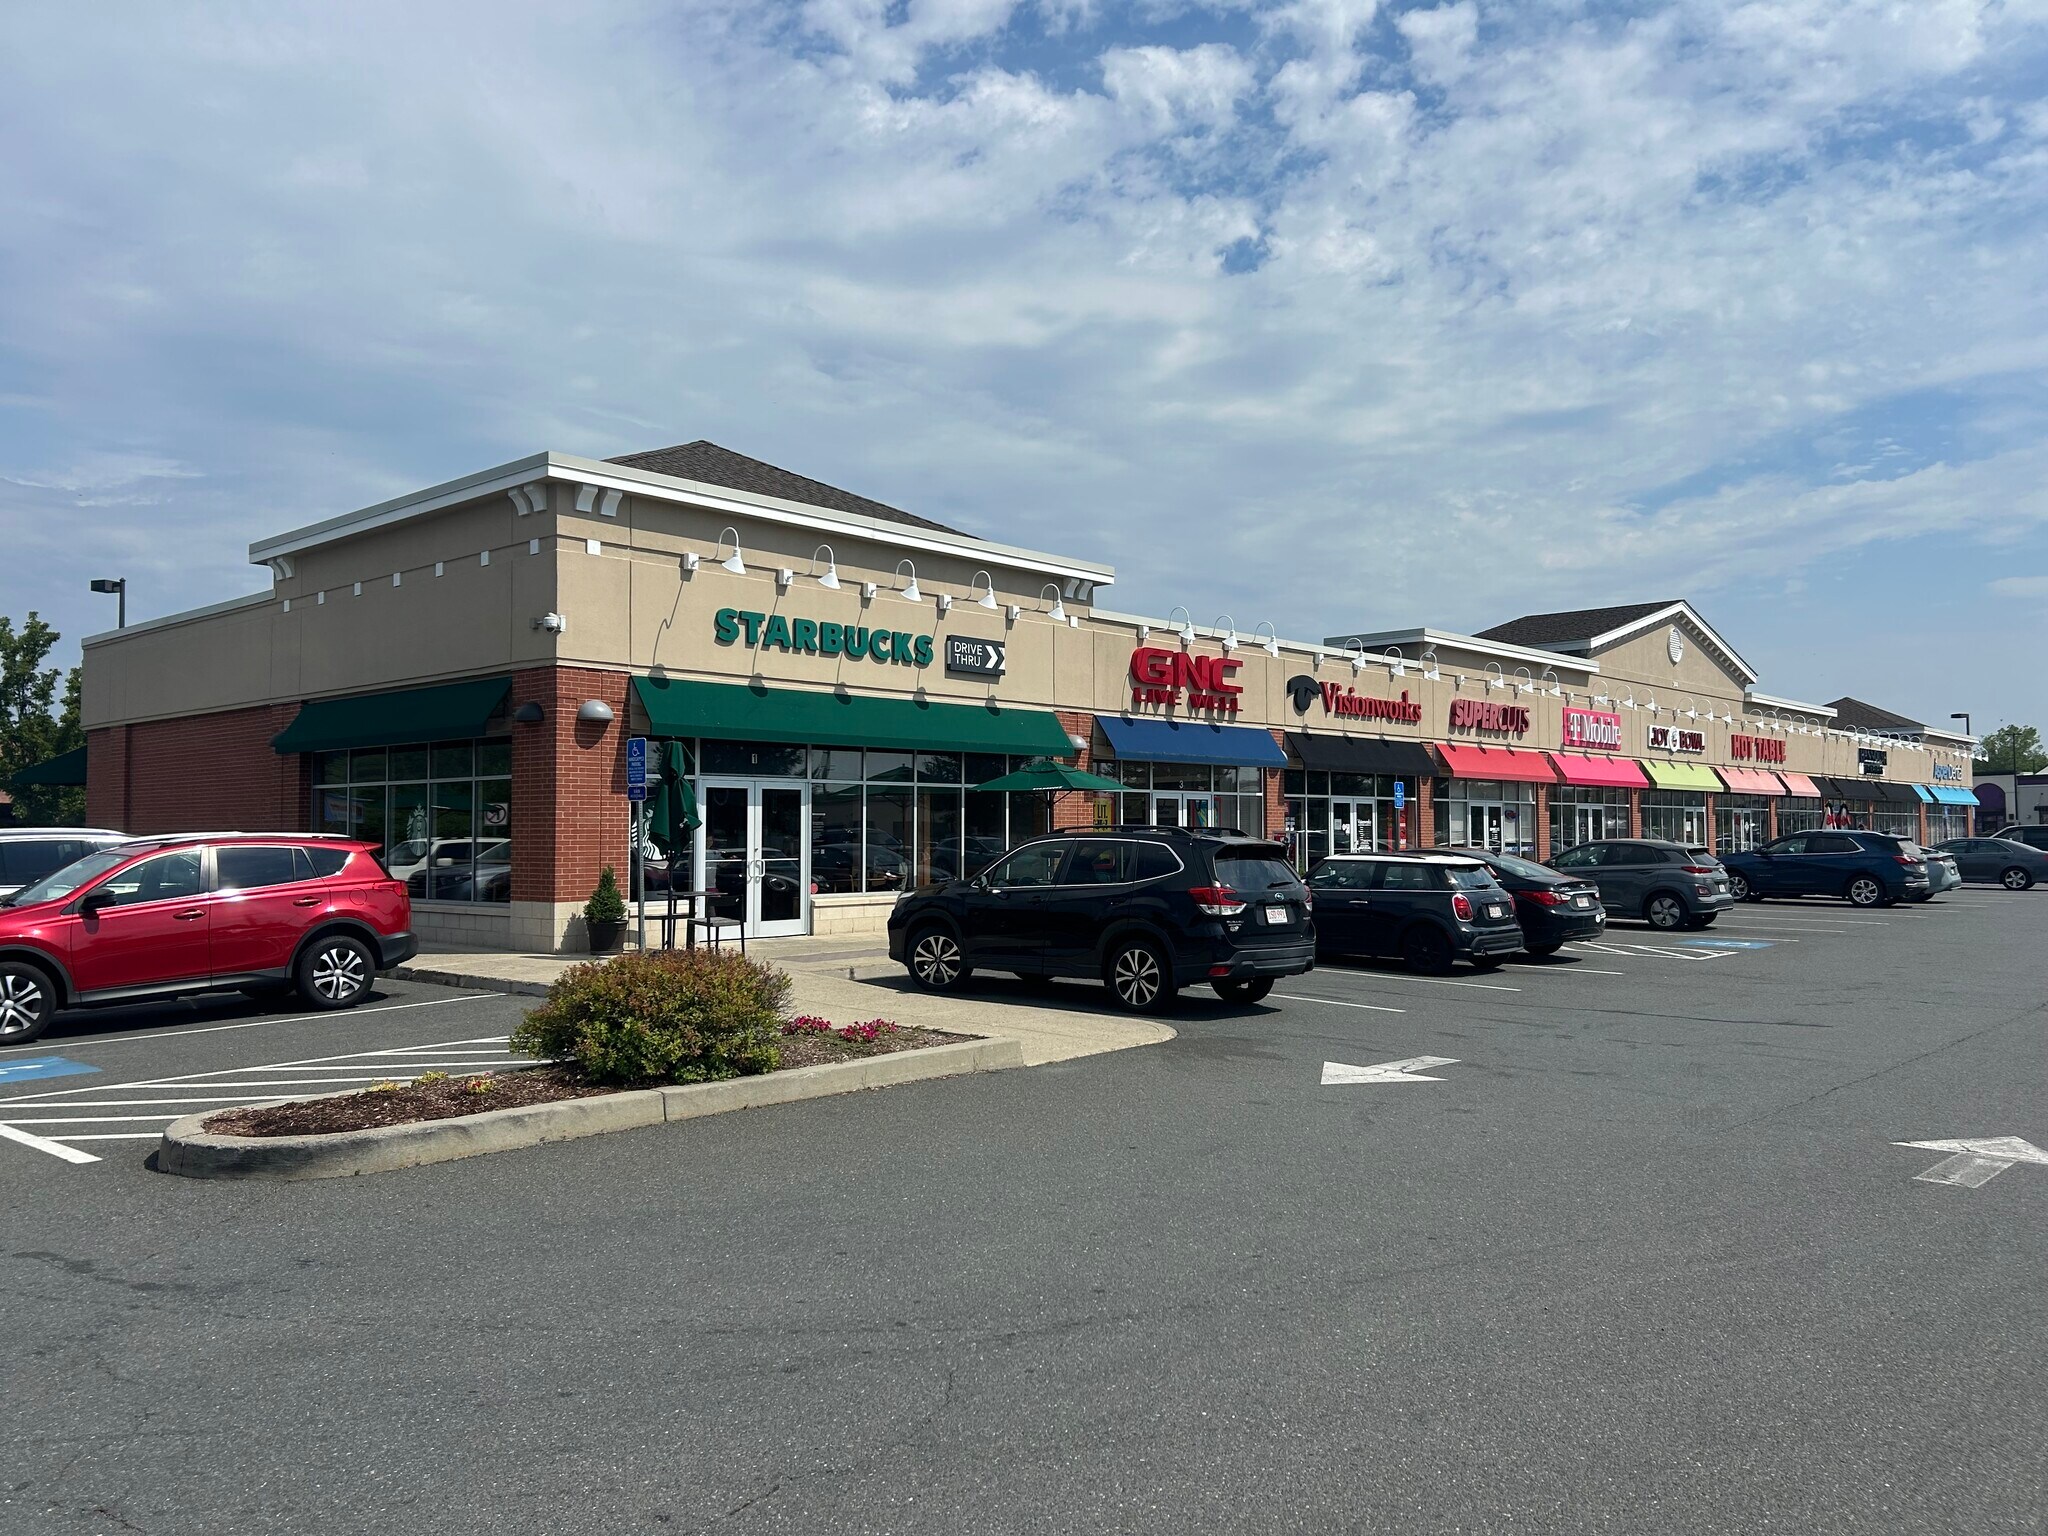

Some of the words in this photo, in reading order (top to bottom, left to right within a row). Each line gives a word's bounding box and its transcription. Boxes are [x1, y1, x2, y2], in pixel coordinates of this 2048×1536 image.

[714, 608, 934, 666] STARBUCKS
[954, 641, 983, 656] DRIVE
[954, 653, 981, 667] THRU
[1130, 646, 1244, 694] GNC
[1133, 687, 1182, 706] LIVE
[1188, 693, 1244, 712] WELL
[1319, 681, 1422, 722] Visionworks
[1450, 699, 1531, 733] SUPERCUTS
[1651, 727, 1670, 747] JOY
[1679, 730, 1705, 751] BOWL
[1731, 734, 1754, 759] HOT
[1754, 737, 1787, 762] TABLE
[1178, 780, 1184, 789] 3
